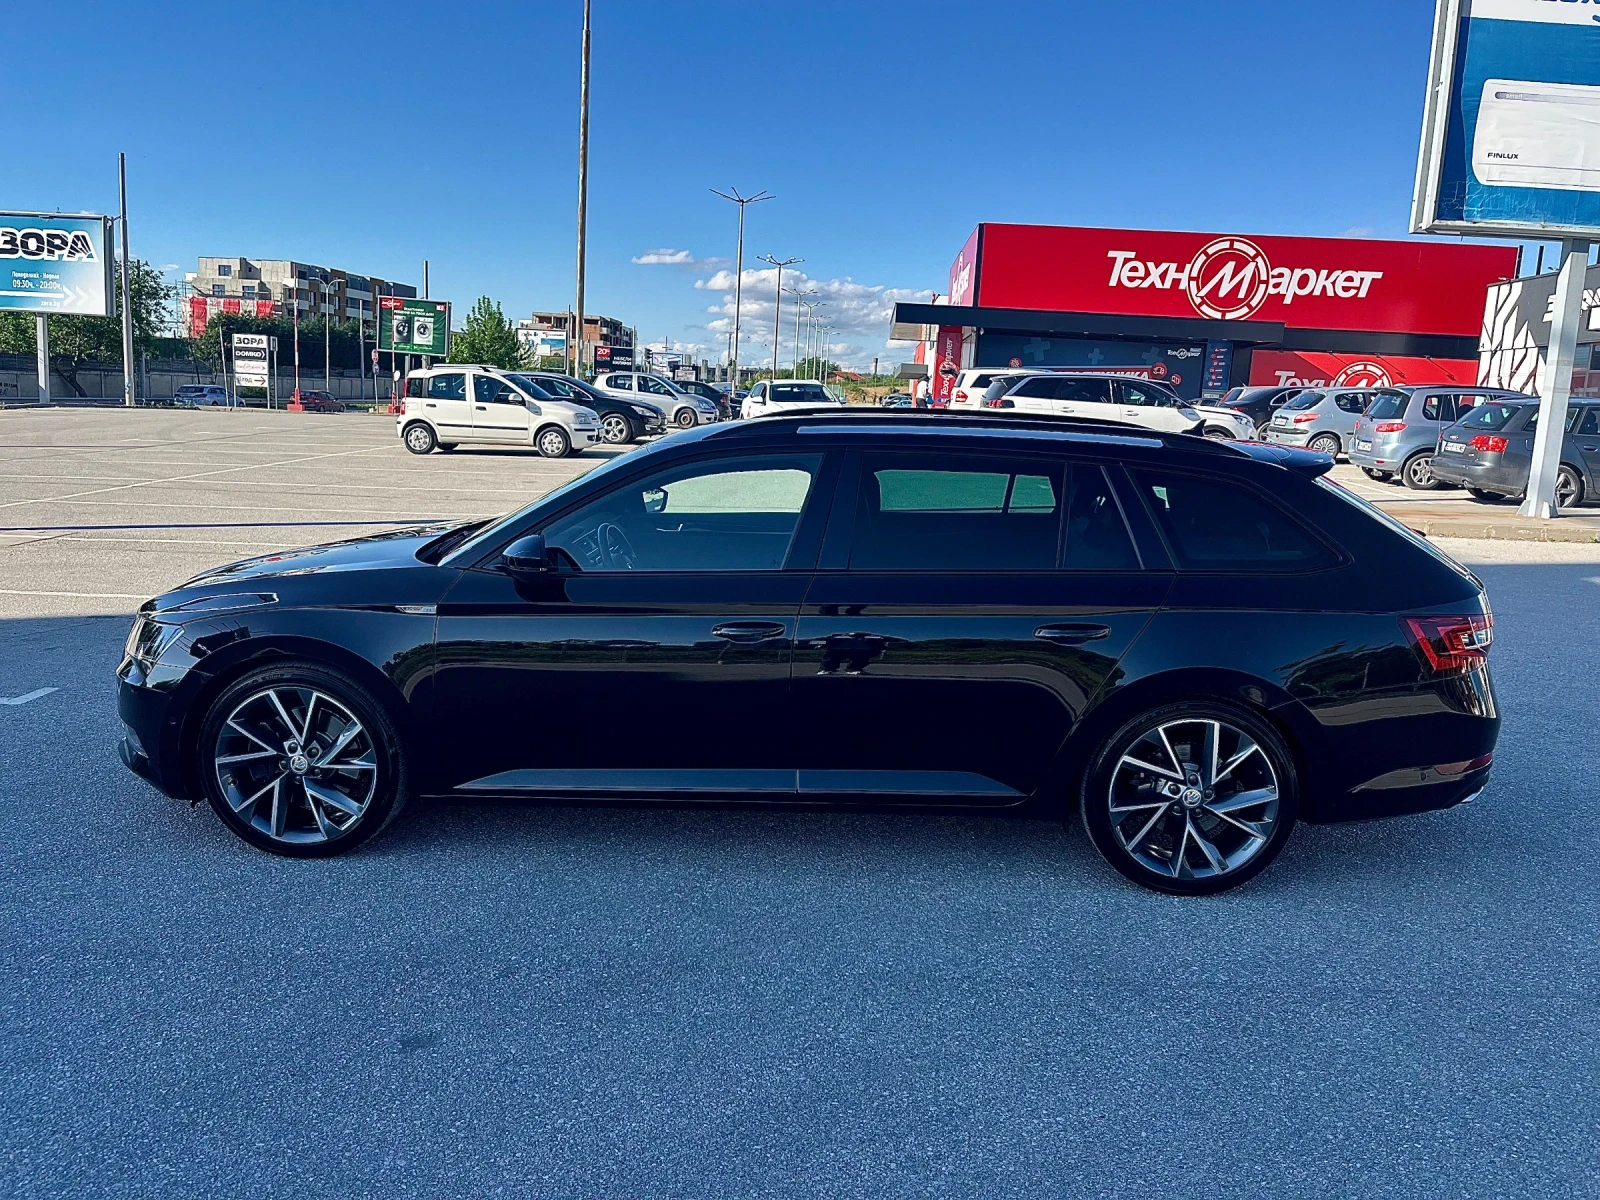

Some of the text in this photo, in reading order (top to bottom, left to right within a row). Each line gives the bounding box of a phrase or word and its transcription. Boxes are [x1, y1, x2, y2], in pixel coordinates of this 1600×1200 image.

[1487, 151, 1519, 160] FINLUX
[0, 230, 95, 260] ЗОРА
[236, 337, 264, 345] ЗОРА
